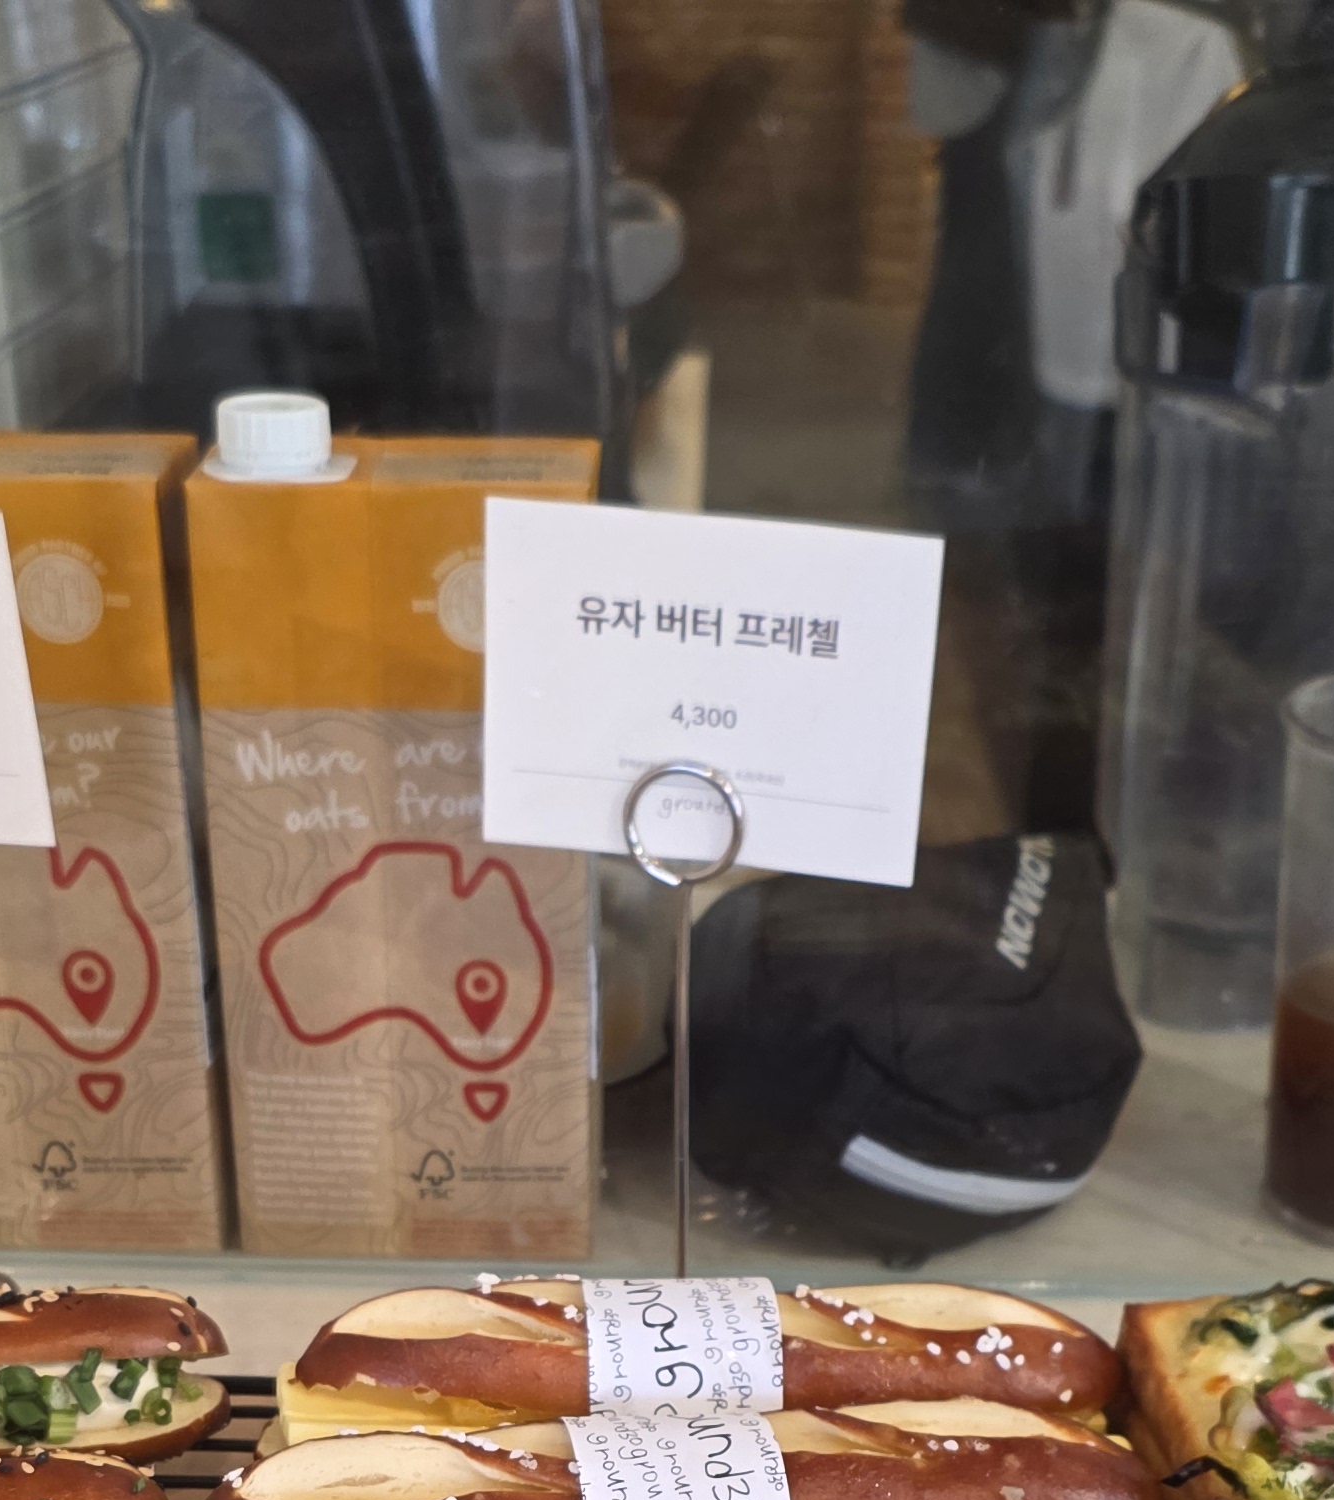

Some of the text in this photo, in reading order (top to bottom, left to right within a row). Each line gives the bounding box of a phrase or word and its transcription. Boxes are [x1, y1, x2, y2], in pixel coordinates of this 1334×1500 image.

[577, 596, 840, 659] 유자 버터 프레첼
[669, 702, 738, 730] 4,300
[235, 727, 468, 783] Where are
[284, 788, 370, 834] oats
